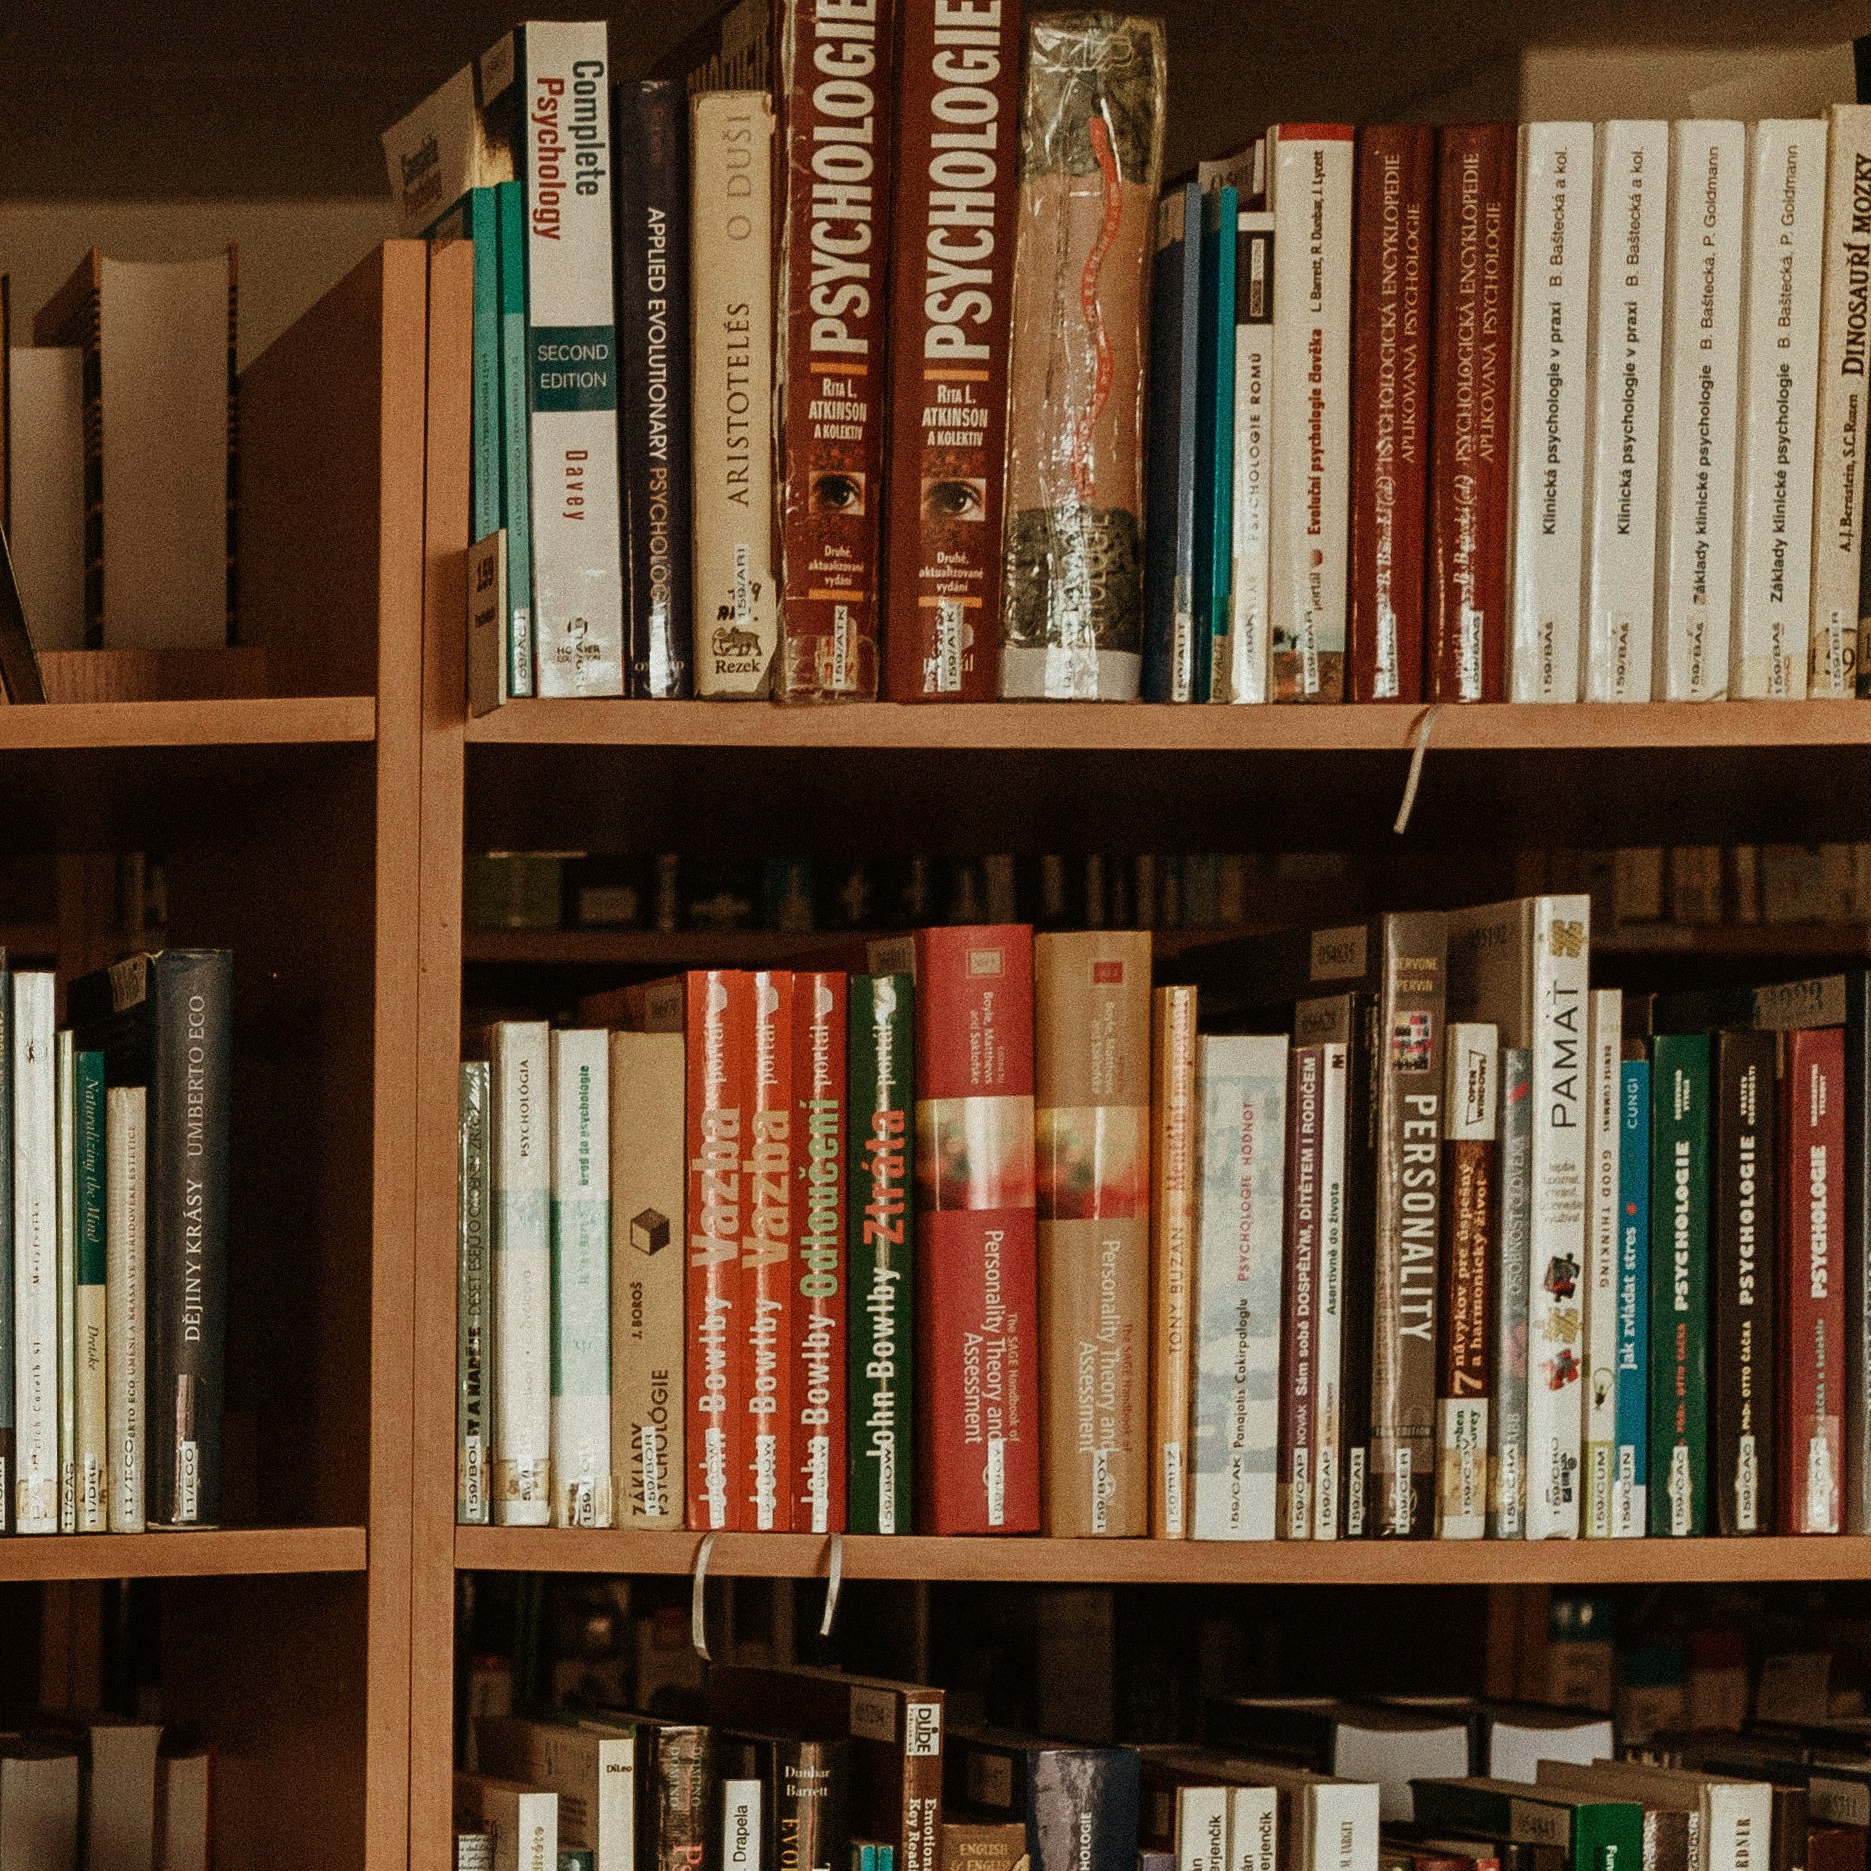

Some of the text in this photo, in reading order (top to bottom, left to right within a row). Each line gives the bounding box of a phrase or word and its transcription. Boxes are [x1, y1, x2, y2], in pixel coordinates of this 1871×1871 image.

[528, 79, 565, 241] Psychology
[570, 63, 607, 197] Complete
[538, 342, 608, 362] SECOND
[539, 372, 606, 390] EDITION
[643, 207, 669, 460] APPLIED EVOLUTIONARY
[725, 303, 748, 506] ARISTOTELÉS
[564, 450, 587, 519] Davey
[690, 1107, 740, 1413] Bowlby Vazba
[796, 1099, 839, 1298] Odloučení
[1397, 1094, 1439, 1340] PERSONALITY
[1669, 1132, 1692, 1310] PSYCHOLOGIE
